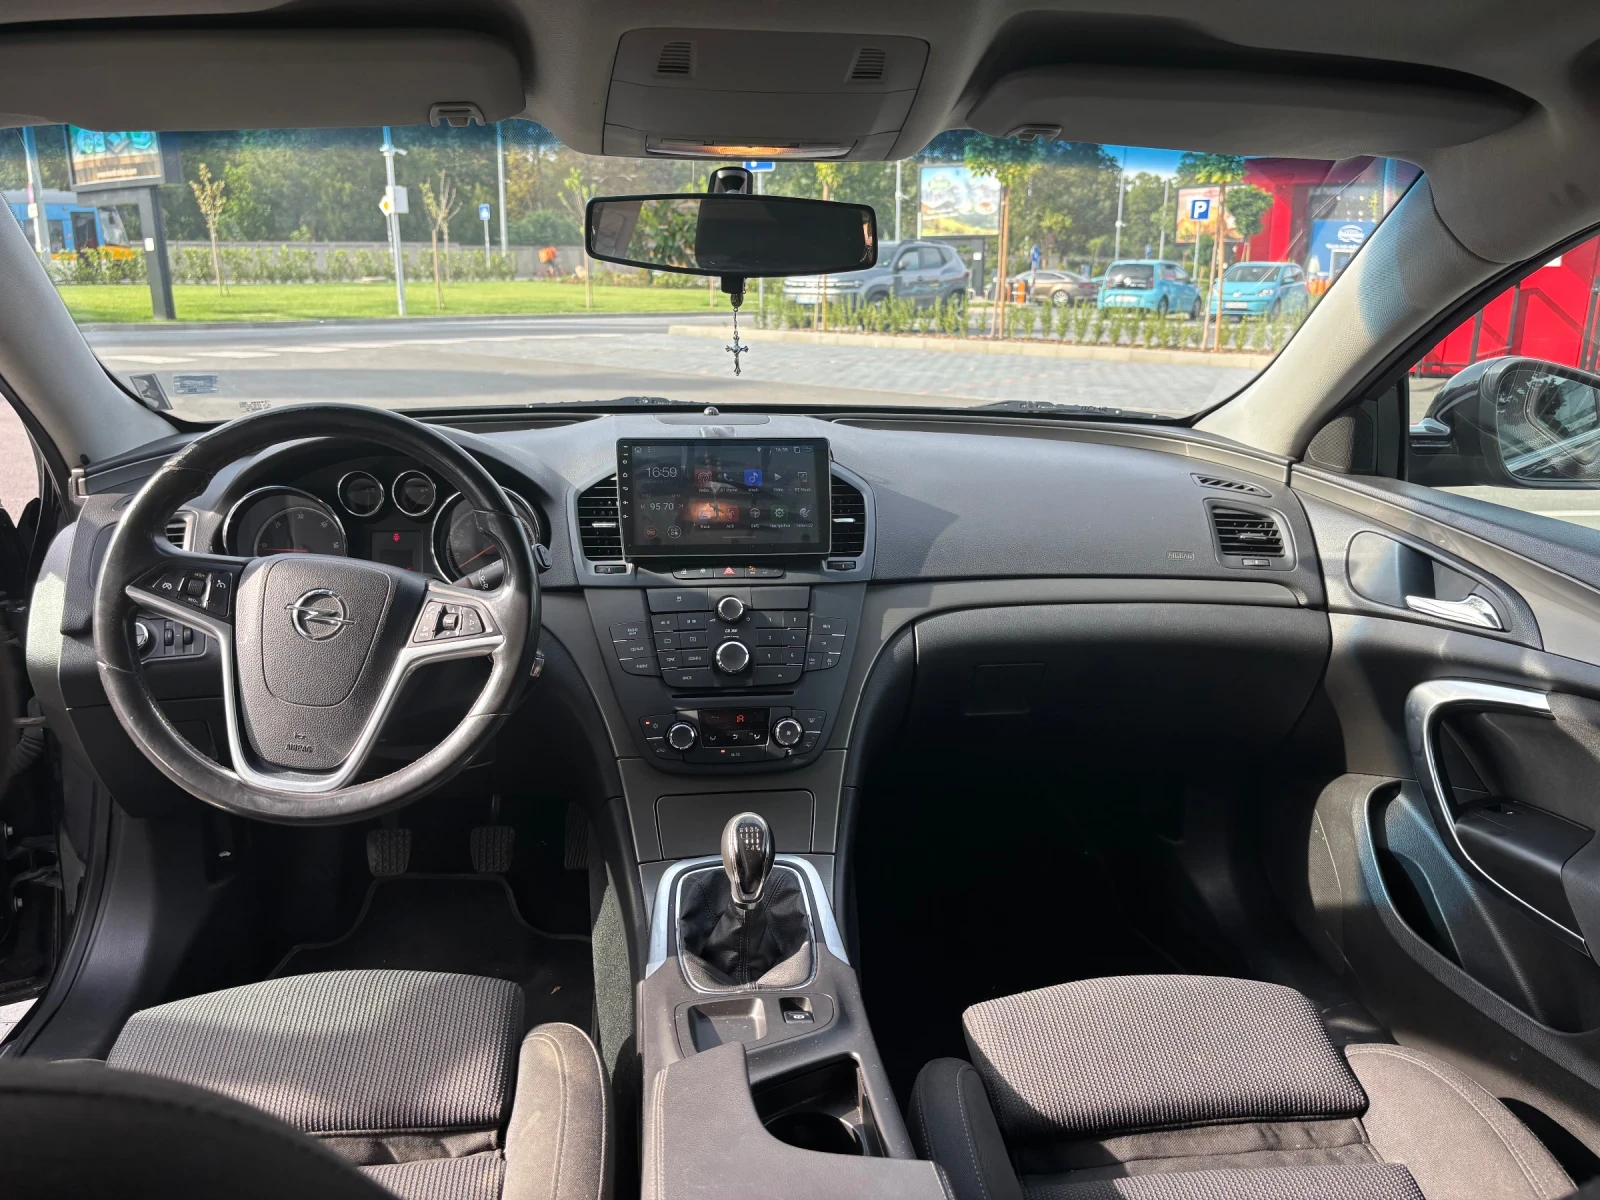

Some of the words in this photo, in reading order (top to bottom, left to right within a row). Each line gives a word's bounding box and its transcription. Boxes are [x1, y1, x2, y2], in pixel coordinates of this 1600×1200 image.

[1194, 201, 1207, 218] P
[645, 466, 677, 478] 16:59
[649, 502, 674, 511] 95.70
